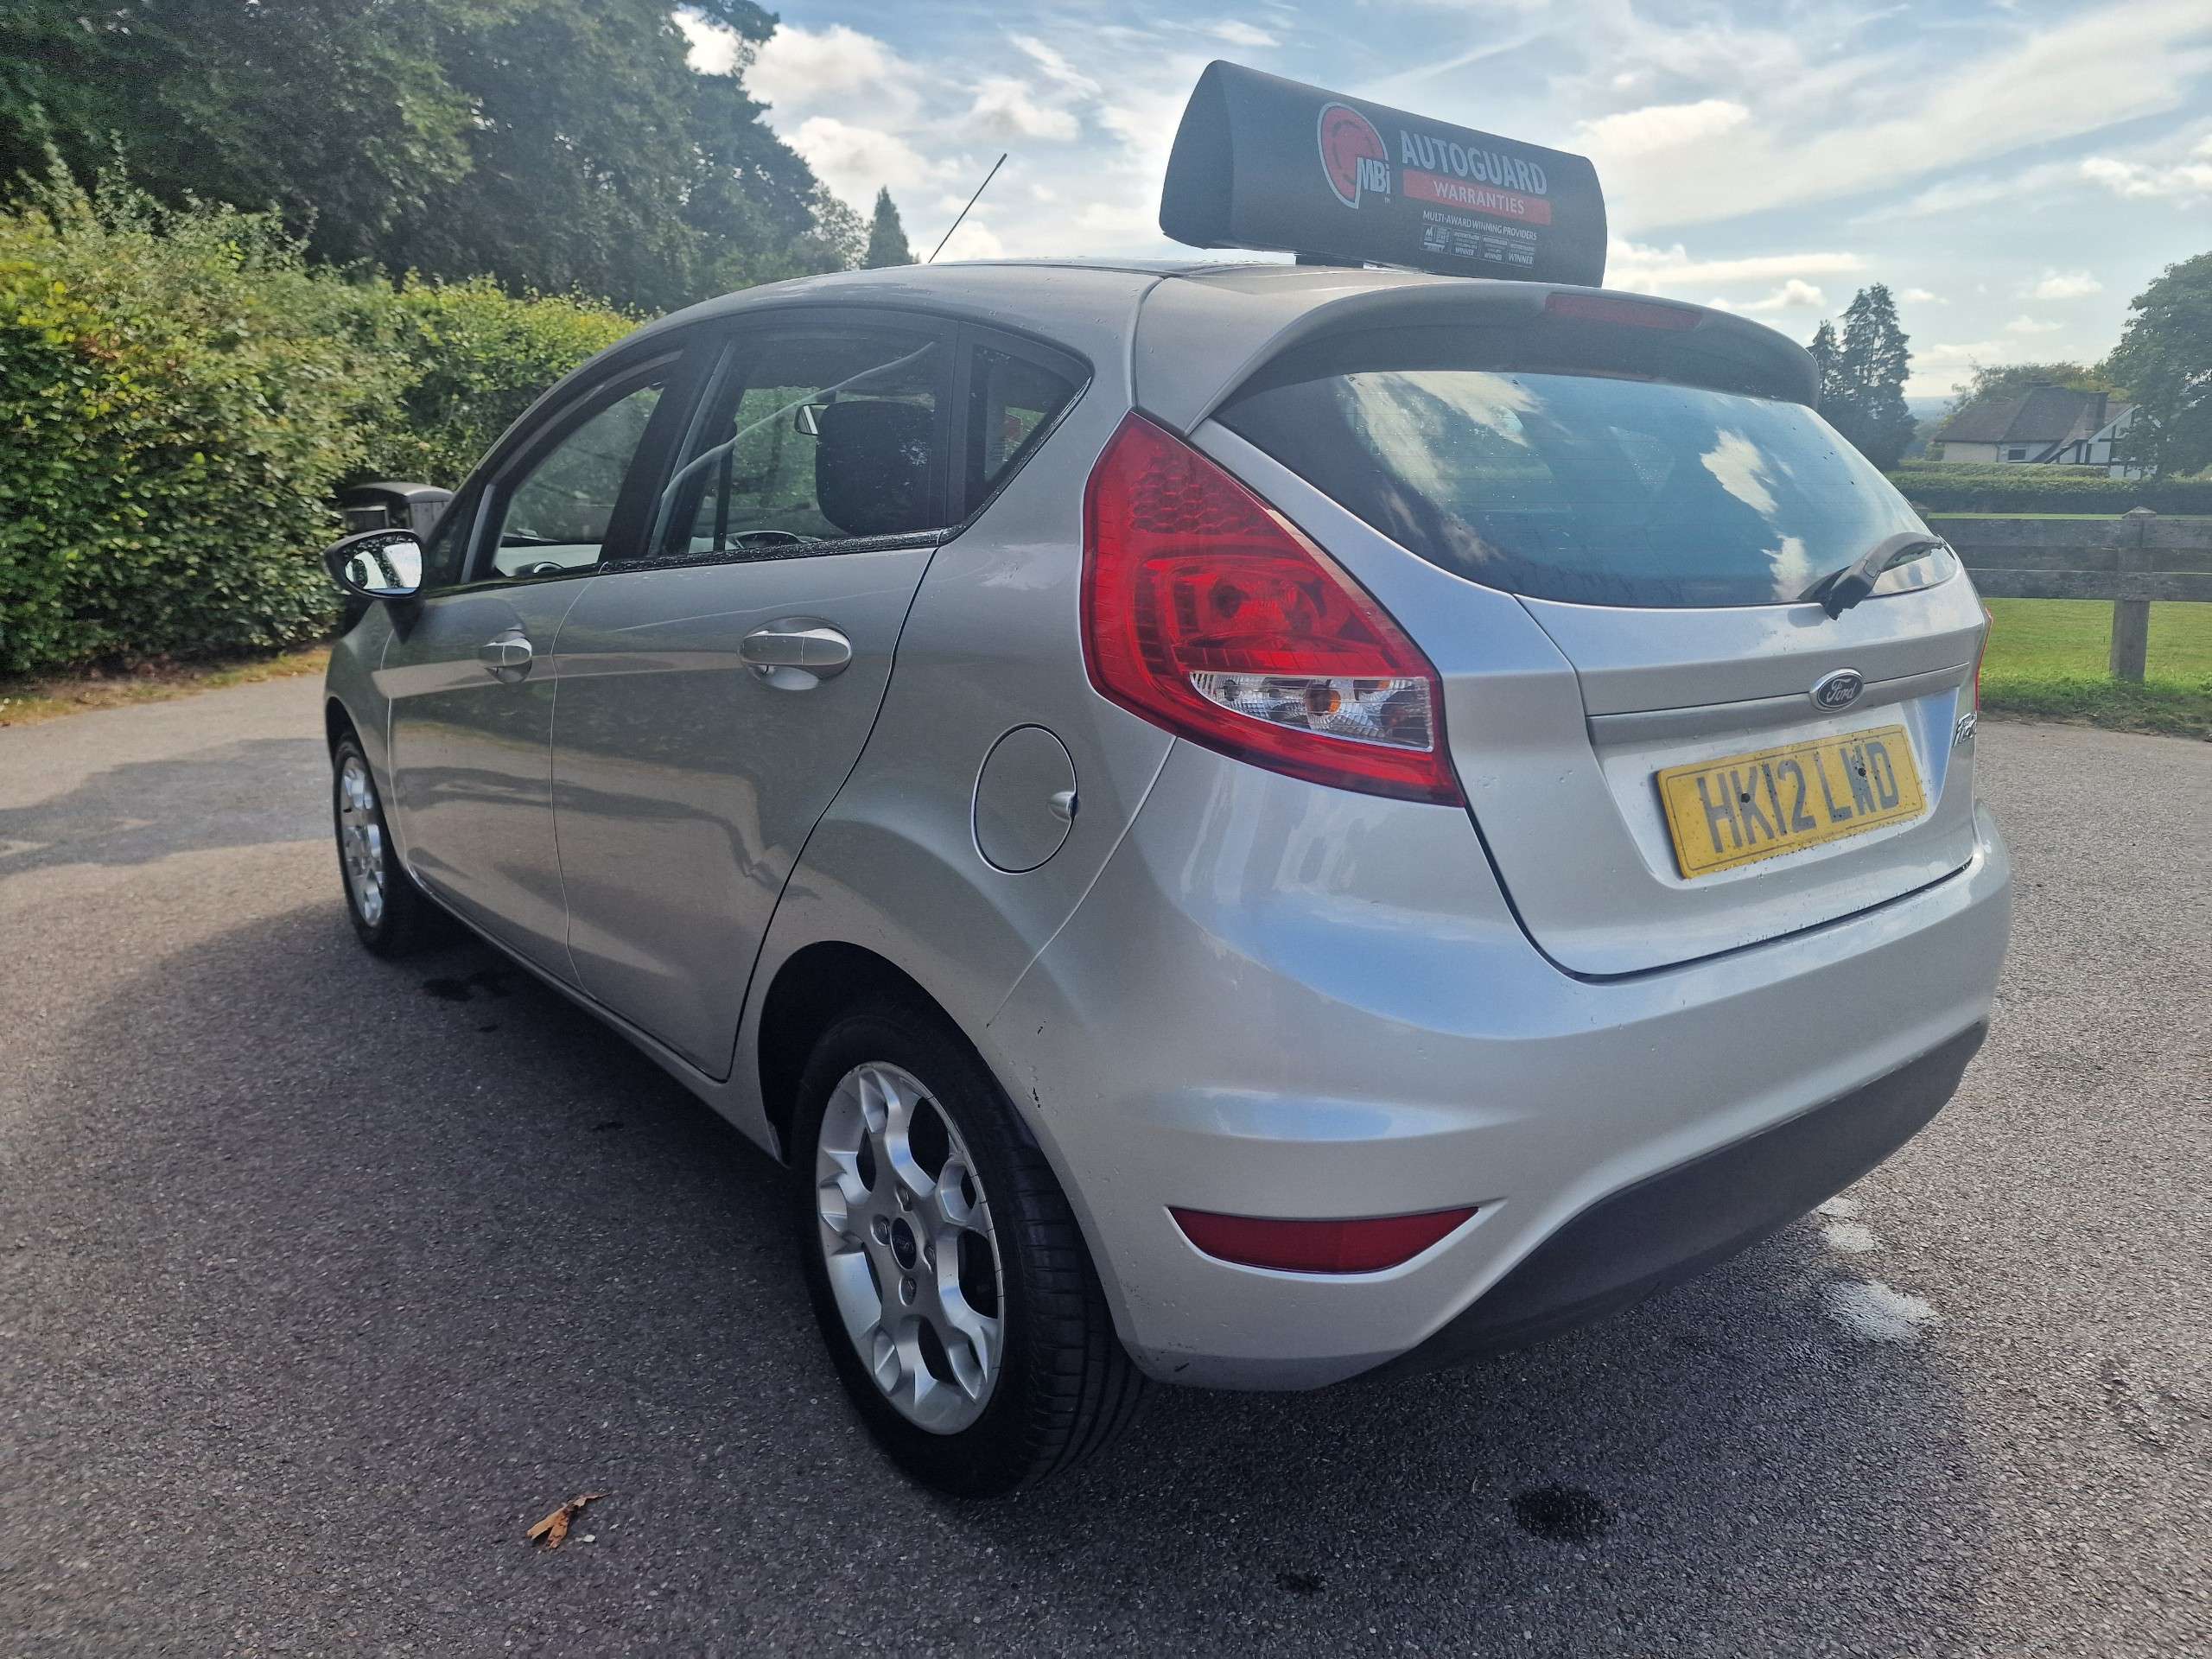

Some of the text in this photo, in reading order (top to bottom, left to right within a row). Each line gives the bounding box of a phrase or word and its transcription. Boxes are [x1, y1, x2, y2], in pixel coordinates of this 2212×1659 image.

[1400, 130, 1548, 195] AUTOGUARD
[1433, 180, 1525, 215] WARRANTIES
[1423, 210, 1537, 240] MULTI-AWARD WINNING PROVIDERS
[1509, 253, 1534, 264] WINNER
[1826, 678, 1858, 703] Ford
[1696, 741, 1899, 854] HK12 LWD
